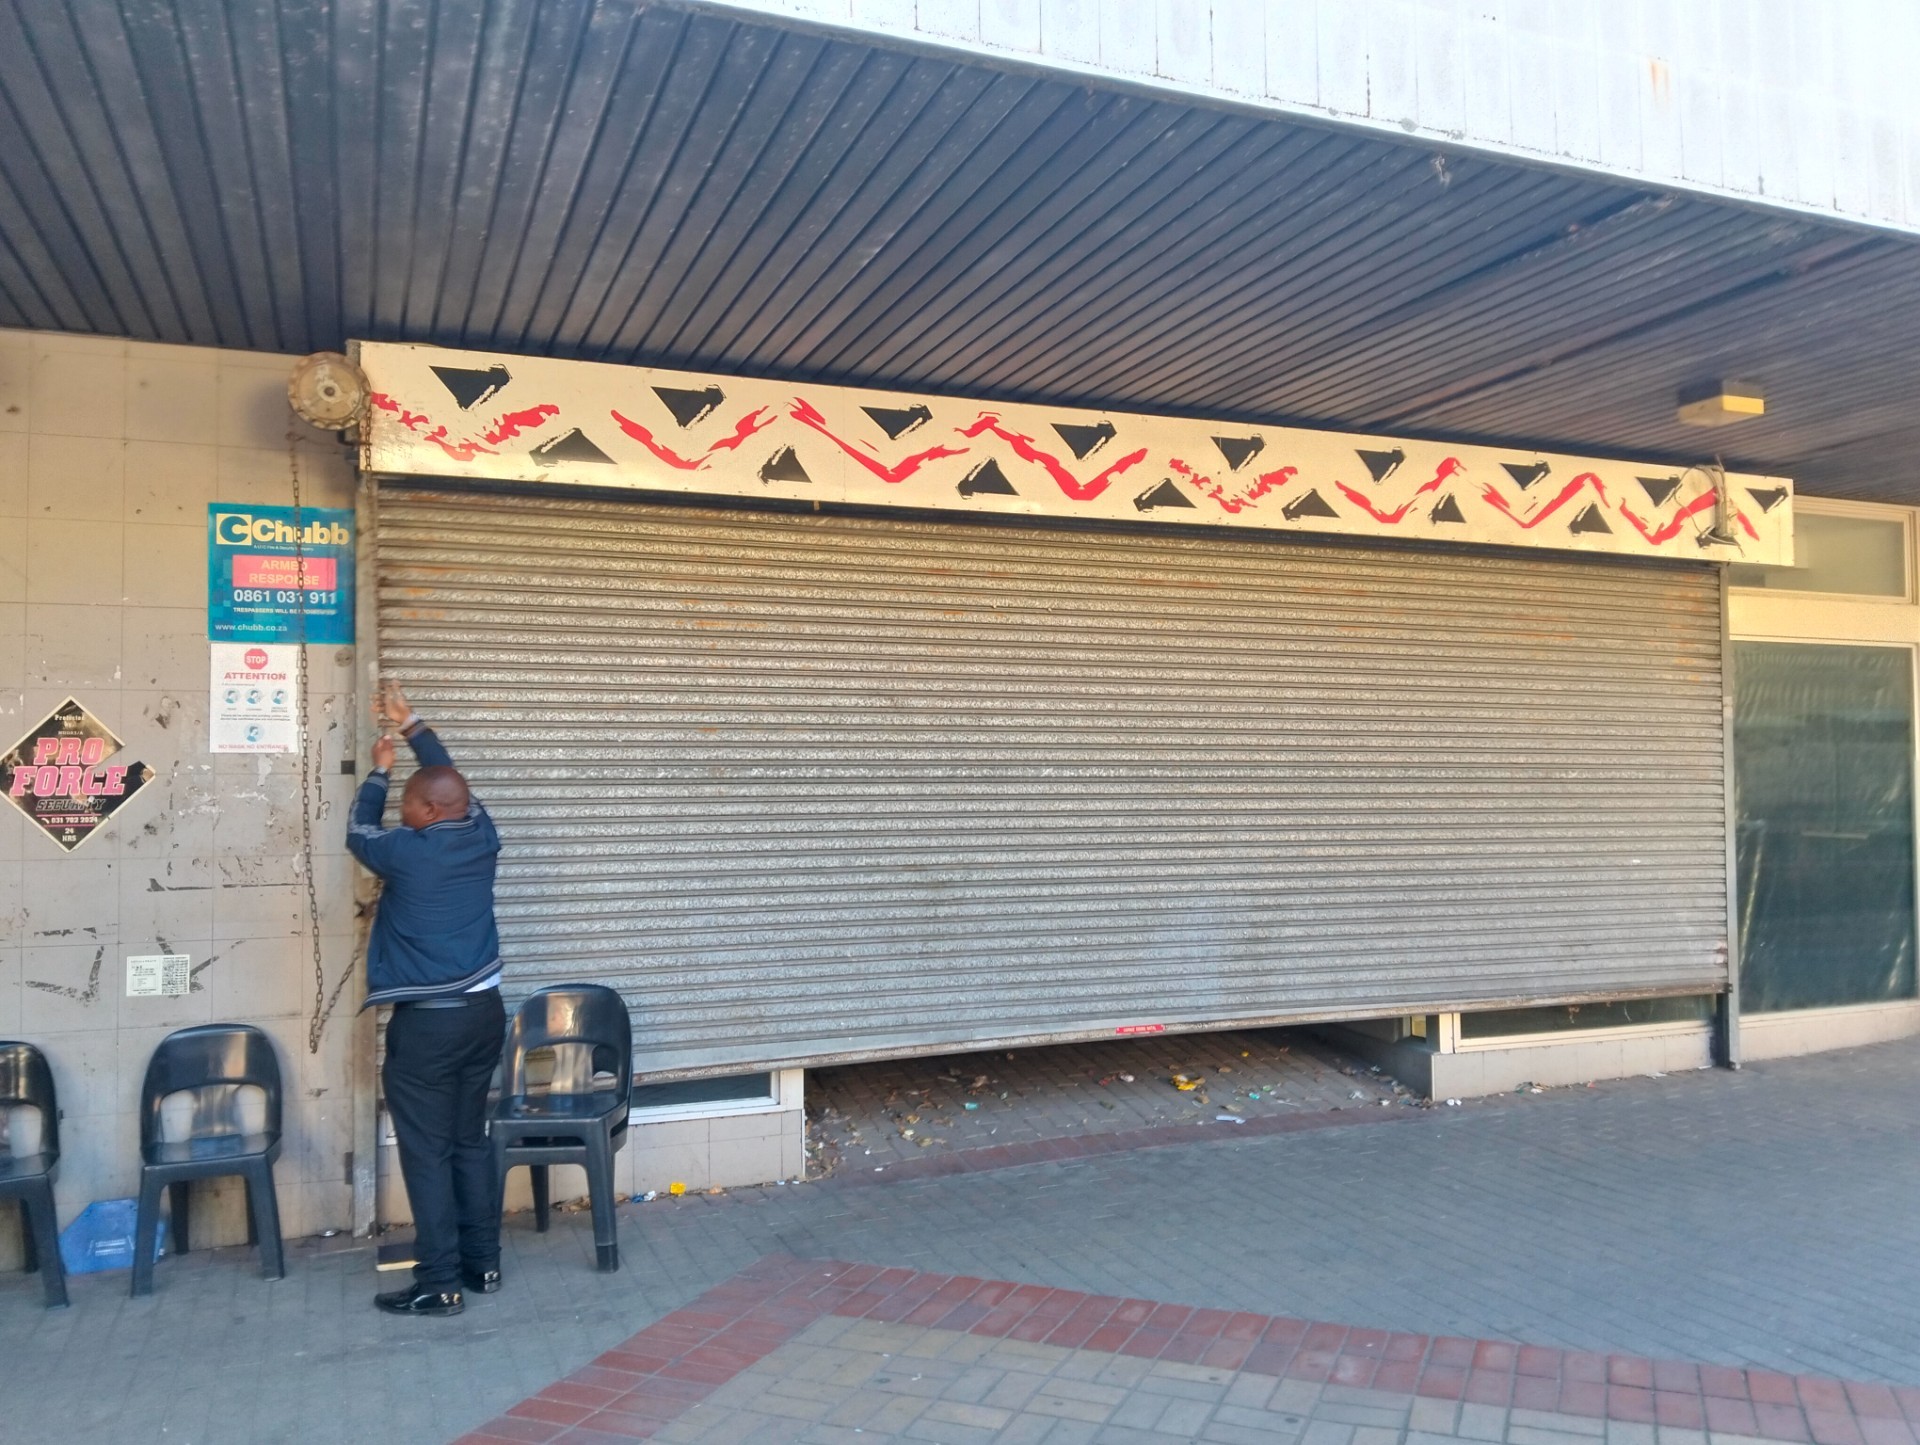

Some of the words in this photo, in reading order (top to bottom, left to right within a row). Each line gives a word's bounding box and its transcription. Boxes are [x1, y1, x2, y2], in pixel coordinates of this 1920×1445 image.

[252, 518, 350, 545] Chubb
[261, 559, 308, 571] ARMED
[234, 589, 270, 602] 0861
[277, 591, 303, 604] 031
[310, 592, 337, 605] 911
[215, 623, 288, 632] www.chubb.co.za
[246, 655, 266, 664] STOP
[224, 672, 287, 681] ATTENTION
[33, 737, 105, 766] PRO
[9, 765, 128, 797] FORCE
